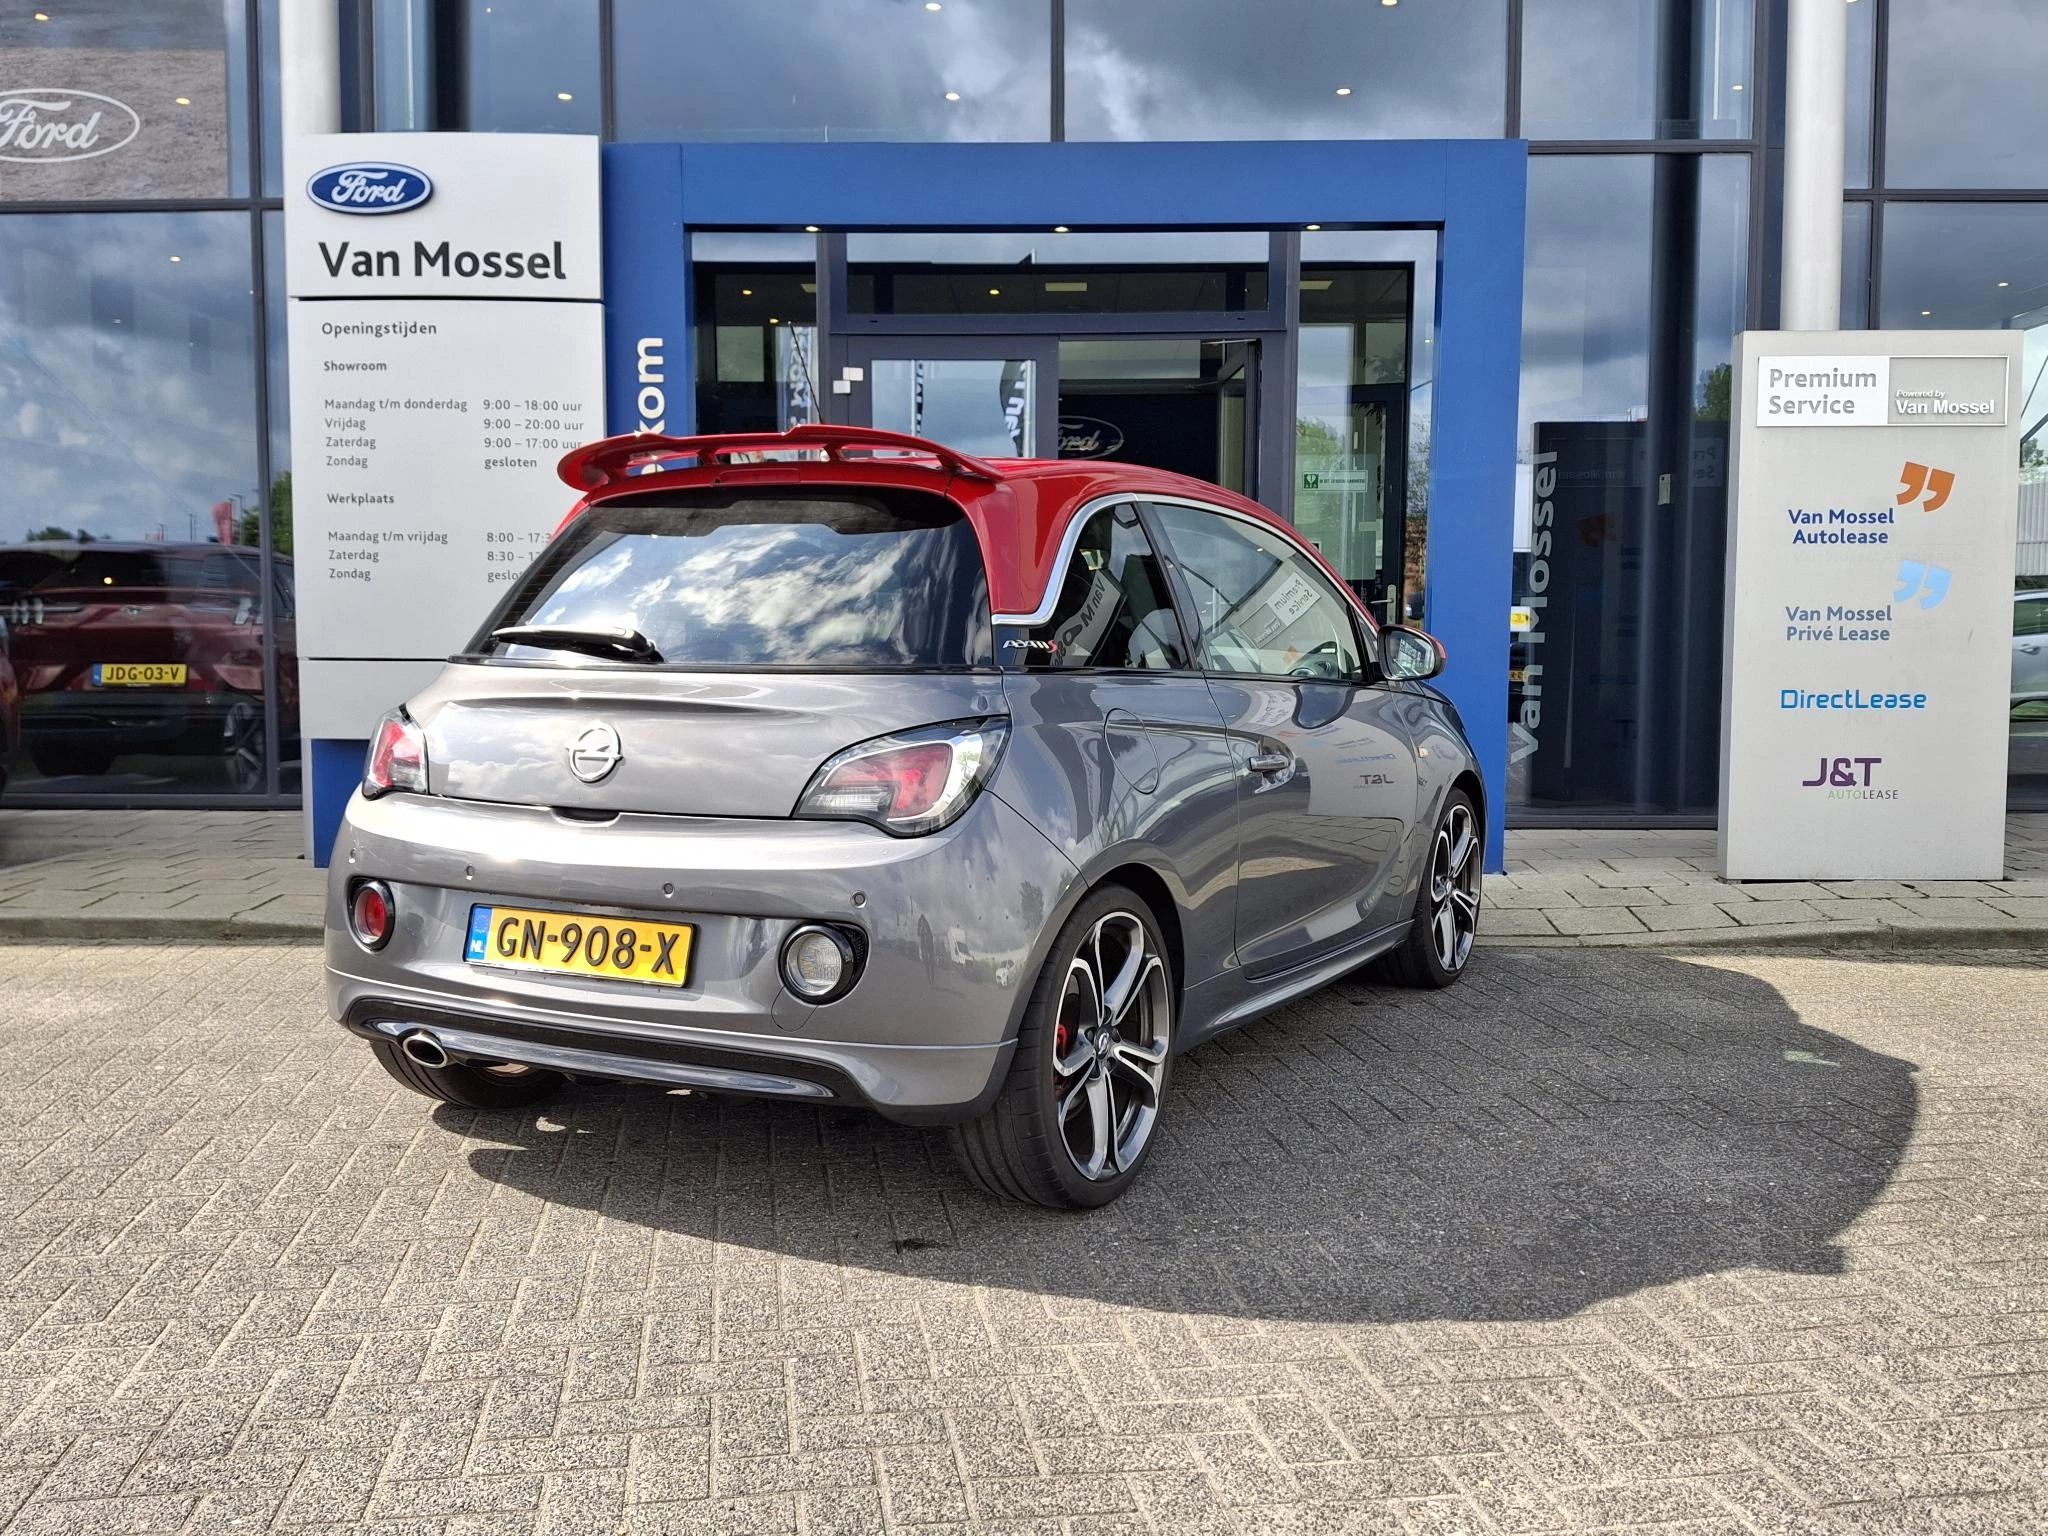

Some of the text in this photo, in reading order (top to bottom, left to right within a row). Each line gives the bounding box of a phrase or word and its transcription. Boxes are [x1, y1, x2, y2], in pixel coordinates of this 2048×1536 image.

[0, 100, 101, 149] Ford
[331, 170, 406, 203] Ford
[318, 240, 567, 280] Van Mossel
[321, 321, 438, 339] Openingstijden
[323, 360, 388, 372] Showroom
[1769, 367, 1877, 389] Premium
[1896, 389, 1946, 399] Powered by
[324, 398, 376, 413] Maandag
[379, 398, 401, 412] t/m
[404, 398, 468, 414] donderdag
[483, 399, 511, 411] 9:00
[524, 400, 559, 412] 18:00
[562, 403, 583, 412] uur
[1768, 394, 1855, 415] Service
[1895, 399, 1995, 415] Van Mossel
[325, 417, 367, 431] Vrijdag
[483, 418, 512, 430] 9:00
[524, 419, 561, 431] 20:00
[564, 422, 585, 431] uur
[325, 437, 377, 450] Zaterdag
[484, 437, 512, 449] 9:00
[525, 438, 559, 449] 17:00
[325, 455, 538, 470] Zondag gesloten
[326, 492, 395, 506] Werkplaats
[1788, 507, 1895, 525] Van Mossel
[328, 530, 378, 545] Maandag
[381, 530, 405, 544] t/m
[407, 531, 449, 546] vrijdag
[486, 532, 515, 543] 8:00
[1792, 527, 1889, 545] Autolease
[328, 549, 380, 563] Zaterdag
[487, 551, 515, 562] 8:30
[1518, 451, 1559, 645] Mossel
[328, 568, 523, 583] Zondag geslo
[1785, 605, 1892, 621] Van Mossel
[1786, 626, 1891, 641] Privé Lease
[105, 666, 179, 681] JDG-03-V
[1780, 689, 1928, 709] DirectLease
[1510, 664, 1544, 765] Van
[1802, 757, 1882, 787] J&T
[1828, 789, 1899, 801] AUTOLEASE
[496, 916, 680, 975] GN-908-X
